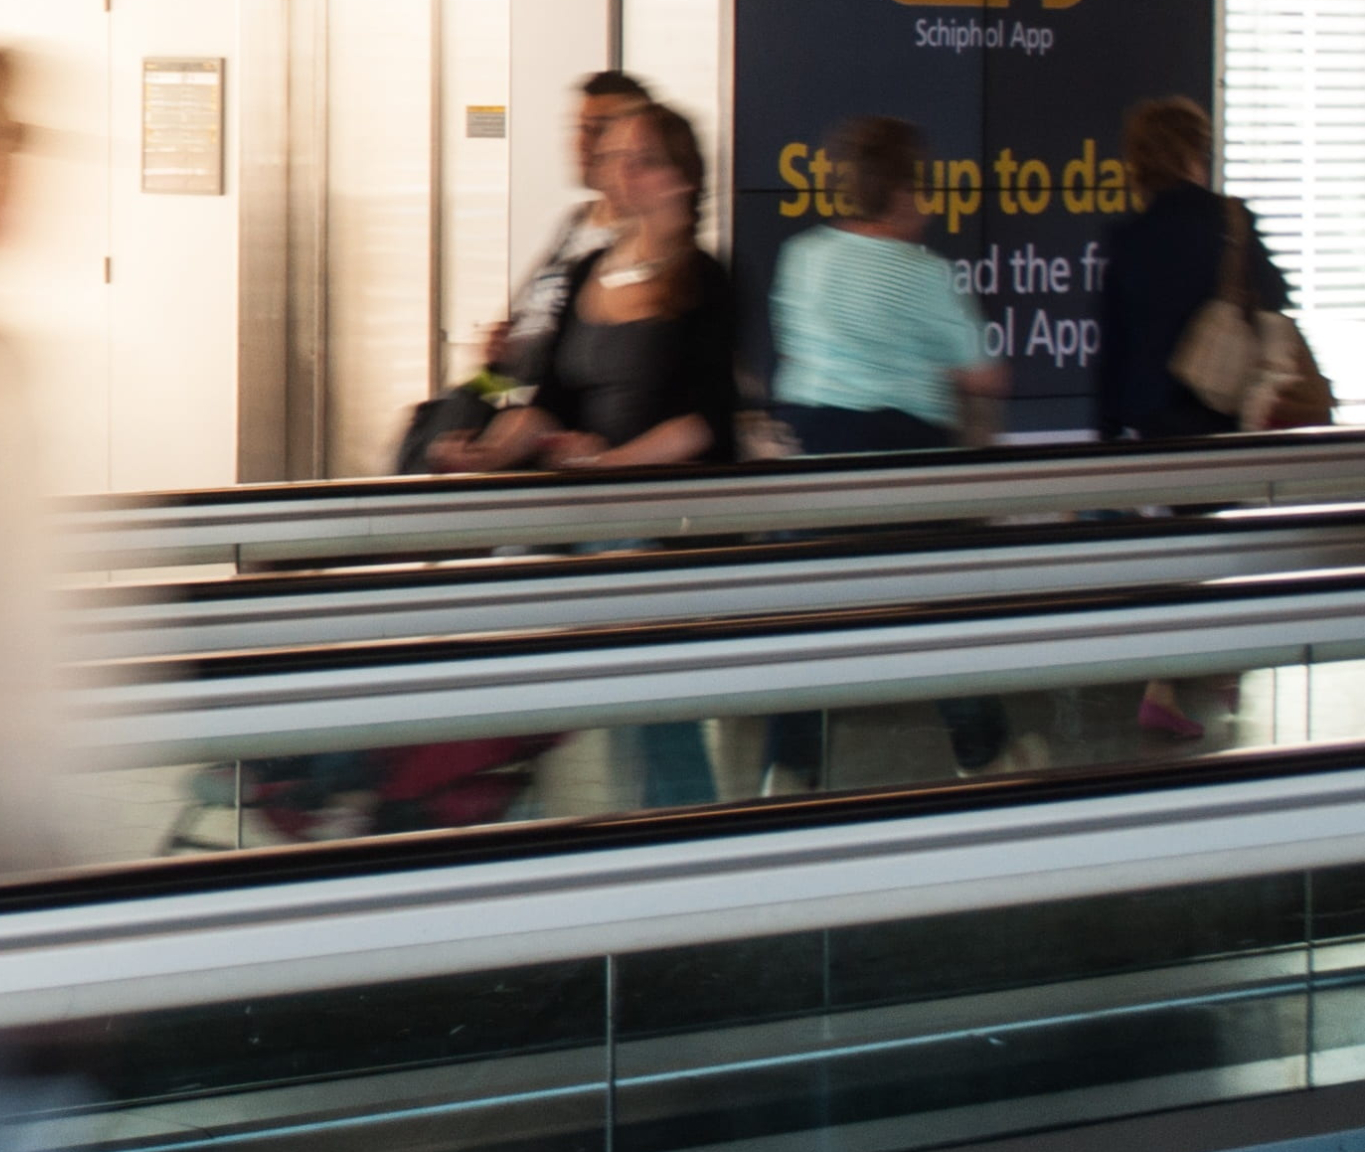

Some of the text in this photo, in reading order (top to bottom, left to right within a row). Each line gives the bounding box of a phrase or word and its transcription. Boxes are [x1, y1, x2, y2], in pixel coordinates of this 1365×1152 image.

[915, 18, 1053, 55] Schiphol App
[779, 139, 1148, 233] Sta up to dat
[1010, 243, 1071, 294] the
[1026, 309, 1101, 368] App
